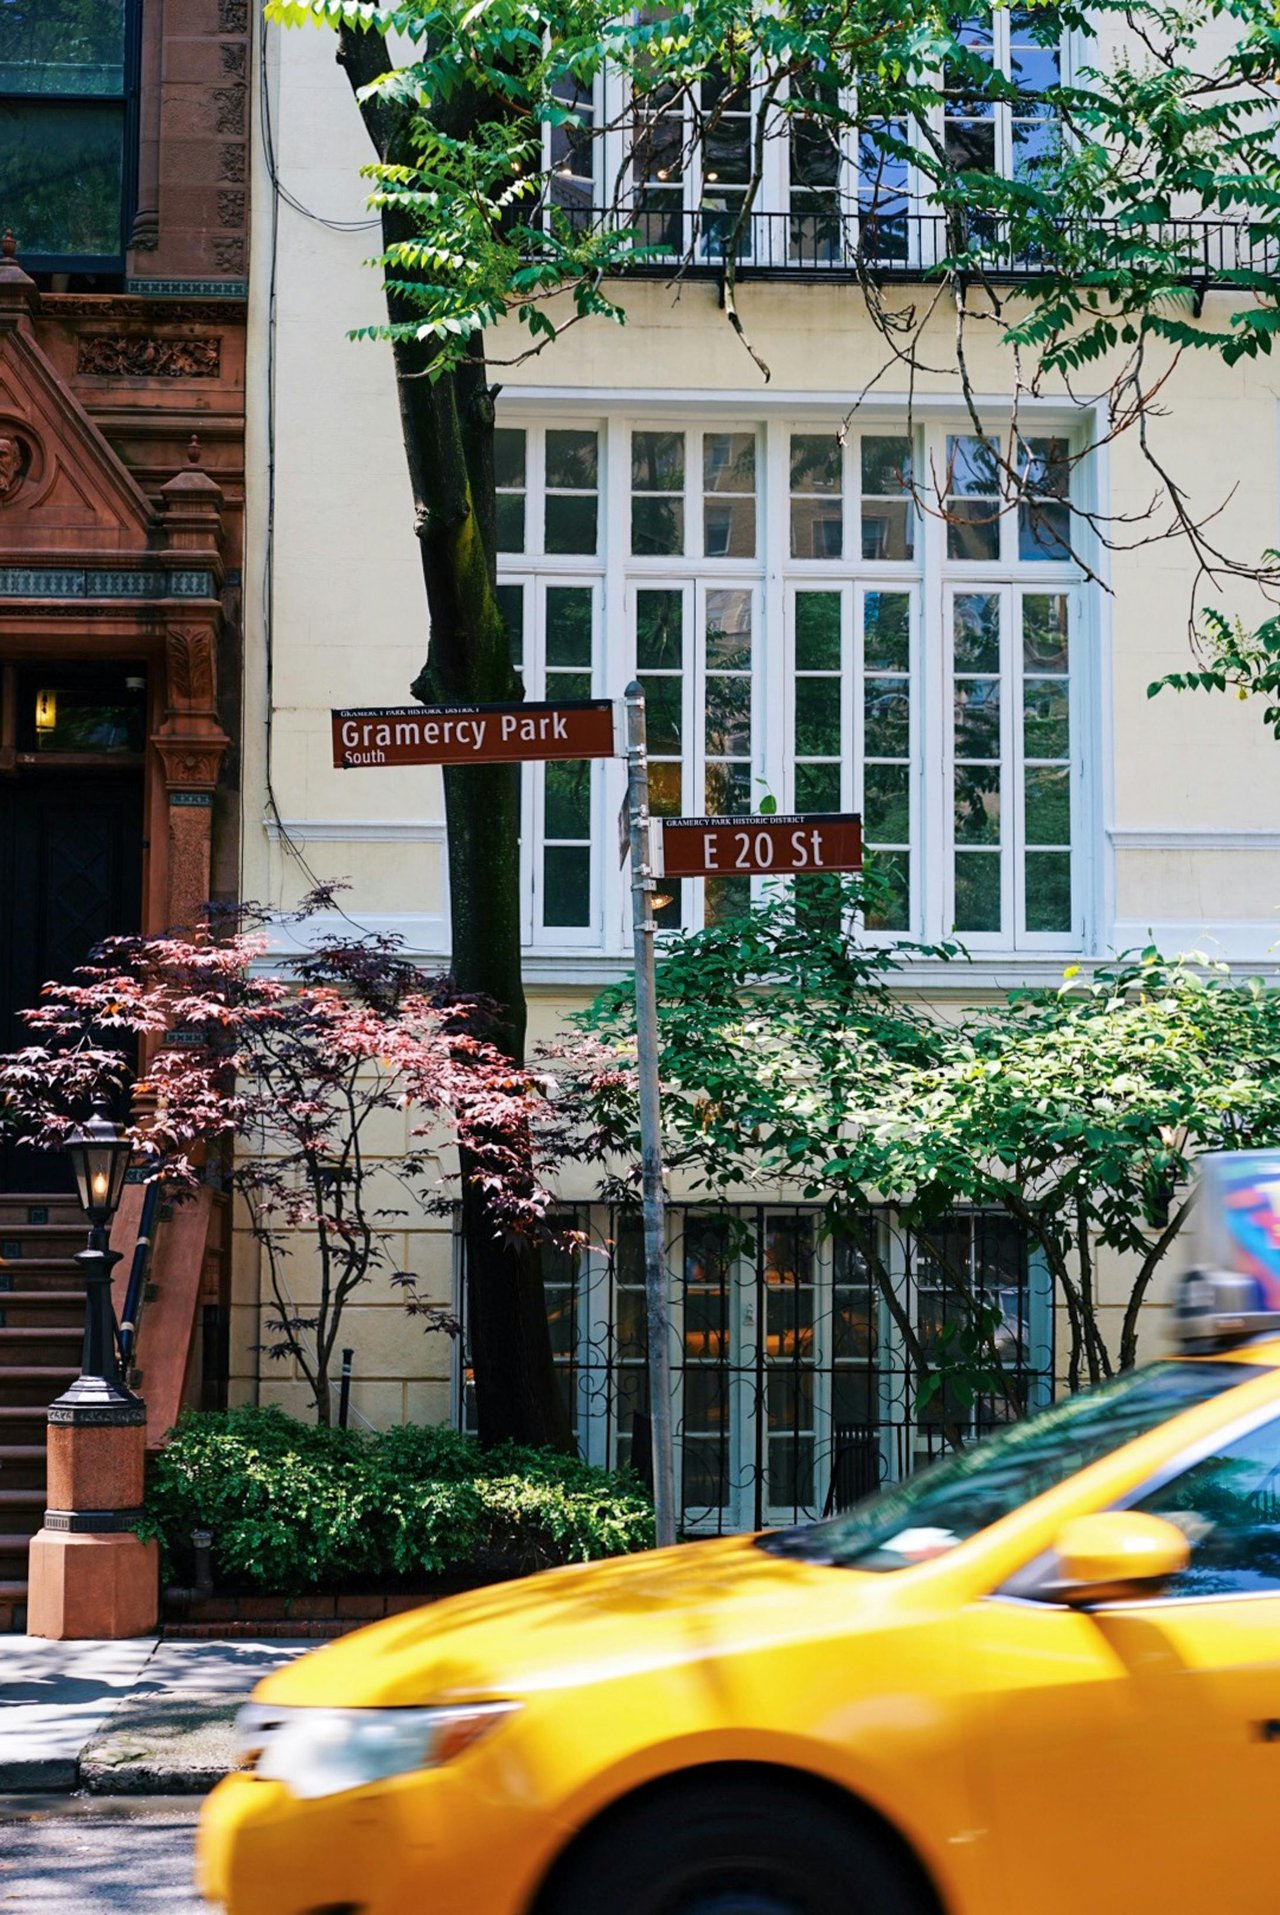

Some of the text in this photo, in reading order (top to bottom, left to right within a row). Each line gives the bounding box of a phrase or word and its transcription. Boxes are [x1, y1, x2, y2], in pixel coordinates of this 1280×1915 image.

[386, 708, 406, 716] PARK
[342, 711, 568, 750] Gramercy Park
[345, 749, 385, 764] South
[666, 816, 805, 827] GRAMERCY PARK HISTORIC DISTRICT
[704, 829, 824, 869] E 20 St
